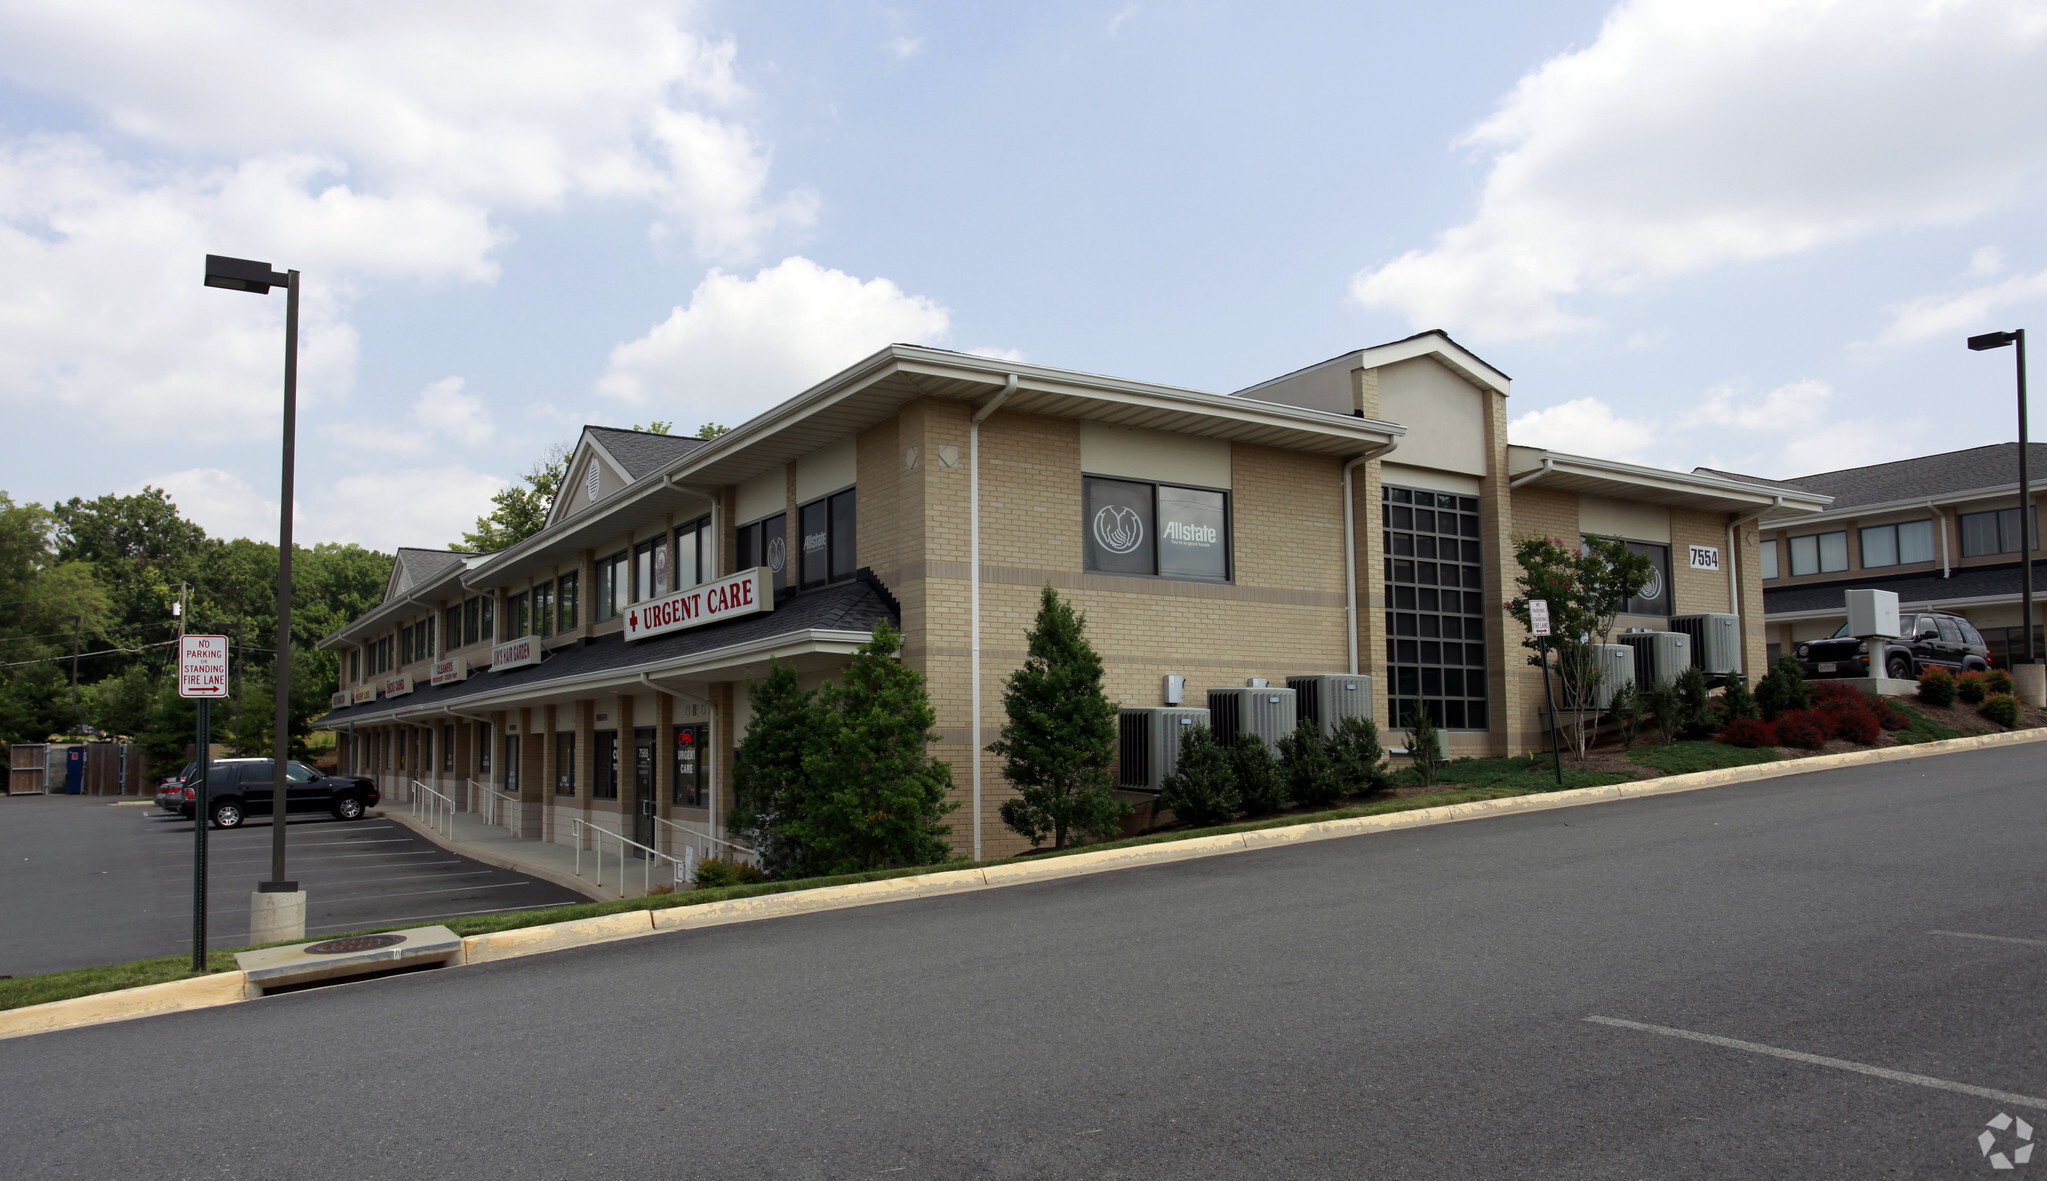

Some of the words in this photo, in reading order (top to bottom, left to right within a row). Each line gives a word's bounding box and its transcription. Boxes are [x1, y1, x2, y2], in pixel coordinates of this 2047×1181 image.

[1163, 521, 1216, 543] Allstate
[803, 531, 826, 551] Allstate
[1691, 548, 1718, 567] 7554
[643, 593, 701, 630] URGENT
[707, 579, 753, 614] CARE
[198, 640, 210, 648] NO
[187, 650, 222, 658] PARKING
[503, 647, 513, 664] HAIR
[513, 642, 530, 661] GARDEN
[184, 665, 224, 673] STANDING
[436, 661, 453, 675] CLEANERS
[184, 675, 201, 685] FIRE
[203, 675, 224, 685] LANE
[638, 748, 649, 758] 7588
[677, 750, 696, 760] URGENT
[680, 764, 693, 774] CARE
